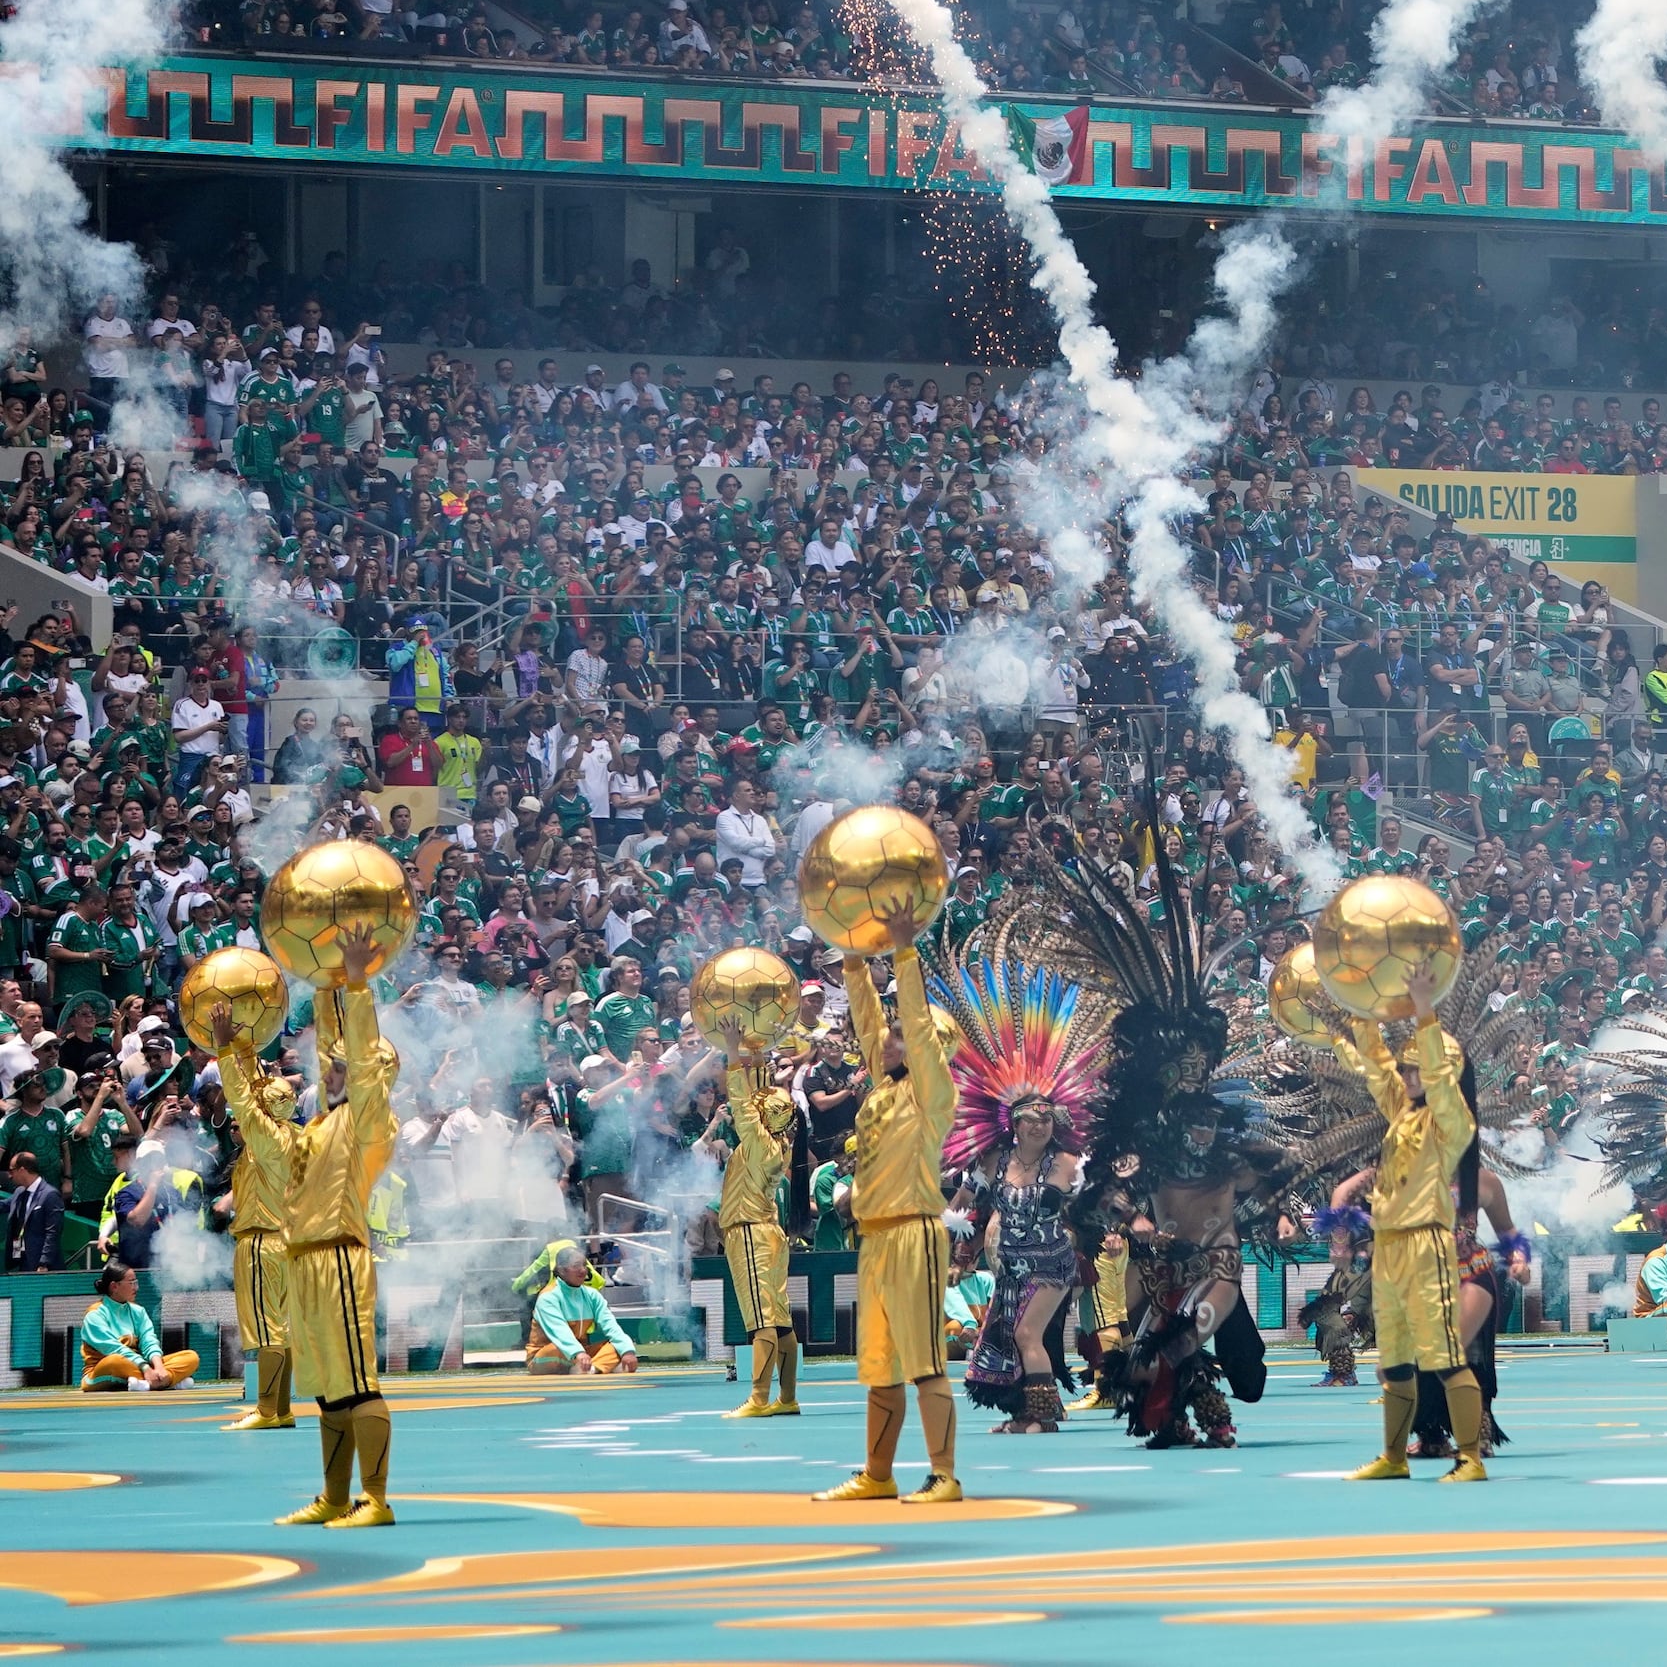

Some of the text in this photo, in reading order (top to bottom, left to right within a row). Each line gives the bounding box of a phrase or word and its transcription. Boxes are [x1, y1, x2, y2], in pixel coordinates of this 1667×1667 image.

[316, 79, 493, 157] FIFA
[821, 107, 988, 181] FIFA
[1301, 132, 1460, 204] FIFA
[322, 404, 333, 416] 19
[1399, 483, 1579, 523] SALIDA EXIT 28
[1489, 537, 1542, 557] RGENCIA
[102, 1133, 111, 1148] 9
